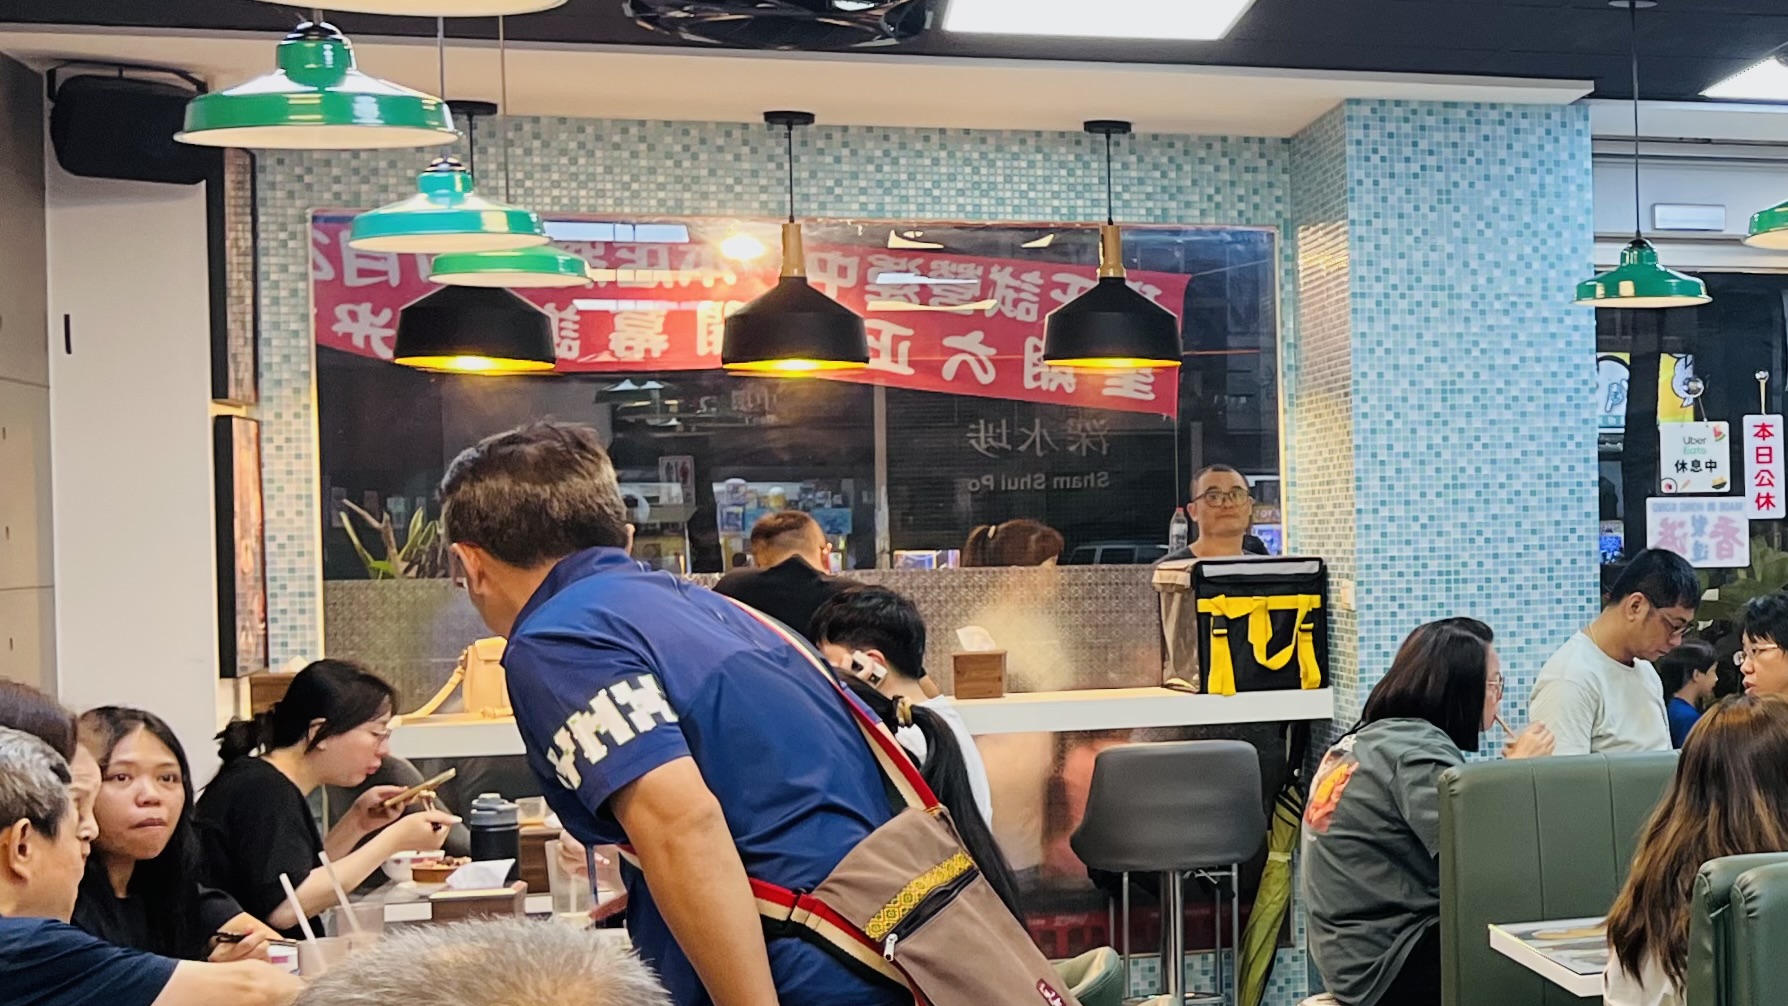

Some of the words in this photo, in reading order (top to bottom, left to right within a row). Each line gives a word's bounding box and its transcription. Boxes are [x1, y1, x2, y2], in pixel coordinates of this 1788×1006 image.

[1683, 436, 1707, 445] Uber
[1683, 446, 1707, 455] Eats
[1674, 459, 1717, 473] 休息中
[1753, 422, 1776, 511] 本日公休
